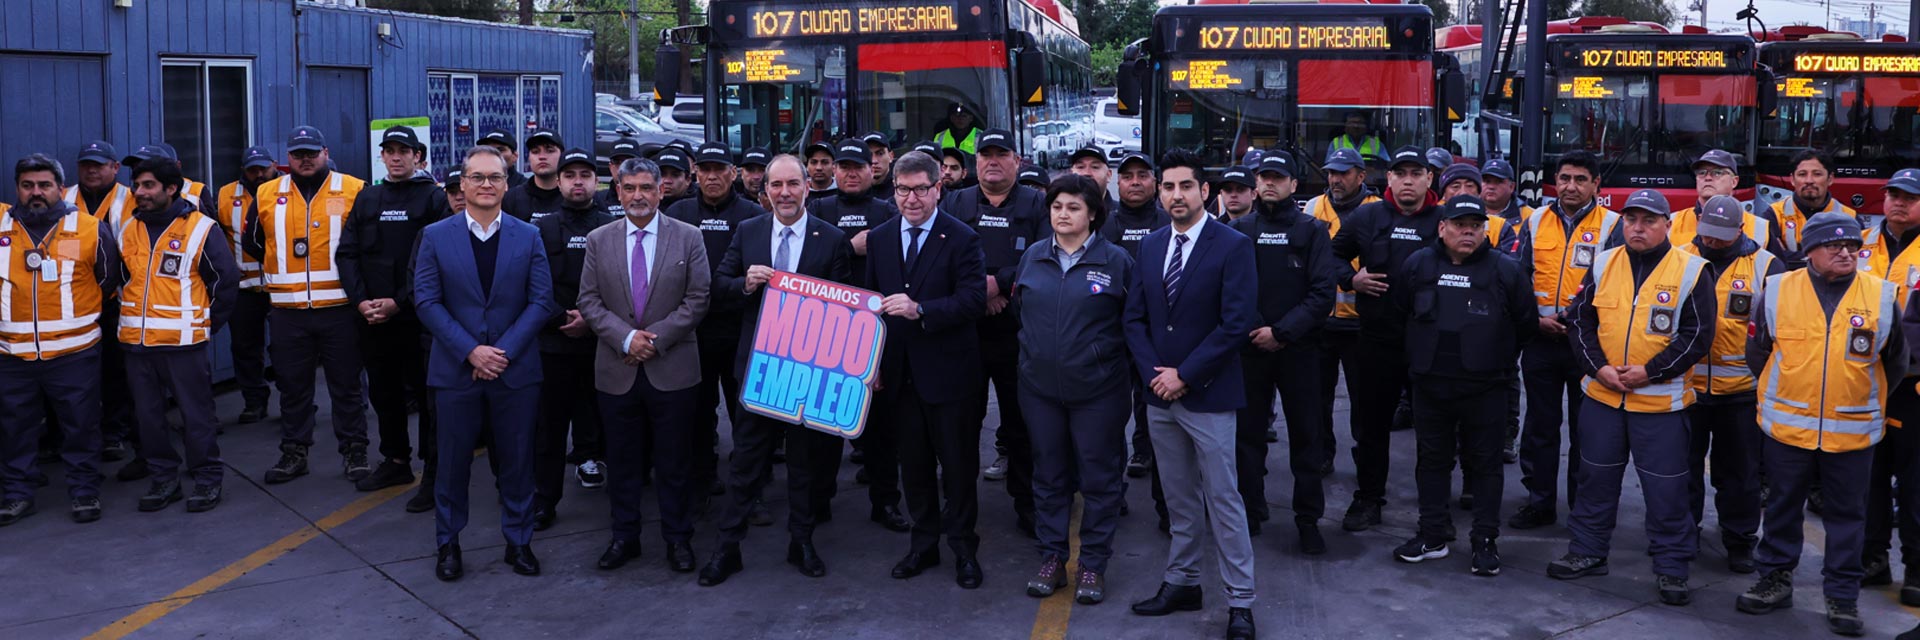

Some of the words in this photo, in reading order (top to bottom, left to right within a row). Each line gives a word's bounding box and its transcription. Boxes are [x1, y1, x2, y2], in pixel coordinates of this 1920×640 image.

[753, 10, 794, 36] 107
[800, 9, 851, 34] CIUDAD
[858, 6, 958, 34] EMPRESARIAL
[1200, 27, 1240, 49] 107
[1243, 27, 1292, 49] CIUDAD
[1298, 26, 1392, 49] EMPRESARIAL
[727, 61, 743, 73] 107
[1582, 50, 1613, 67] 107
[1615, 50, 1652, 67] CIUDAD
[1656, 50, 1727, 67] EMPRESARIAL
[1795, 55, 1824, 71] 107
[1825, 56, 1860, 72] CIUDAD
[1863, 56, 1920, 72] EMPRESARIA
[1171, 70, 1188, 81] 107
[1560, 83, 1573, 92] 107
[1630, 177, 1675, 185] FOTON
[1597, 194, 1611, 207] ed
[1440, 274, 1469, 282] AGENTE
[779, 275, 861, 305] ACTIVAMOS
[754, 287, 877, 377] MODO
[744, 351, 865, 428] EMPLEO
